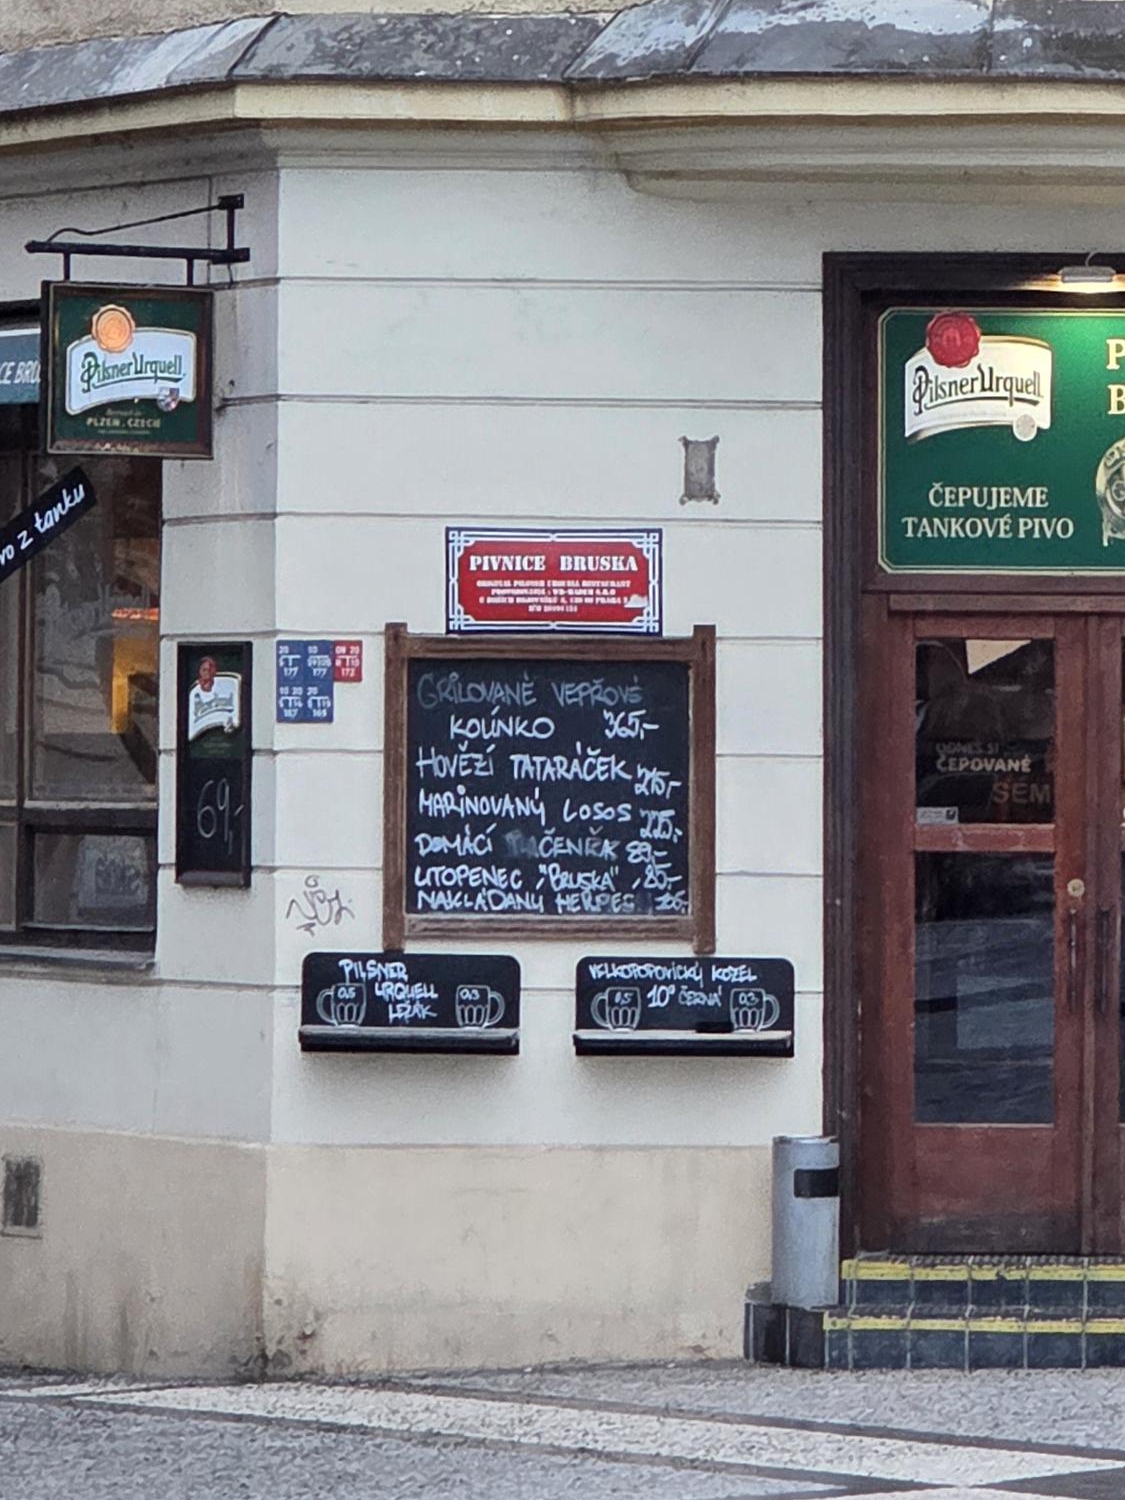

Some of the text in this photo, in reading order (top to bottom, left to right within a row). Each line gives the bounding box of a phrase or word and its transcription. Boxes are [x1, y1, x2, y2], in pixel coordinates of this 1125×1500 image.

[80, 351, 182, 393] Pilsner Urquell
[912, 363, 1041, 416] Pilsner Urquell
[34, 483, 86, 534] tanku
[929, 483, 1049, 508] ČEPUJEME
[903, 513, 1074, 539] TANKOVÉ PIVO
[469, 555, 638, 572] PIVNICE BRUSKA
[415, 739, 496, 779] HOVĚZÍ
[509, 741, 633, 781] TATARÁČEK
[936, 754, 1032, 773] ČEPOVANÉ
[418, 784, 546, 826] MARINOVANÝ
[414, 822, 497, 858] DOMÁCÍ
[339, 959, 408, 982] PILSNER
[711, 964, 758, 982] KOZEL
[374, 981, 439, 1001] URQUELL
